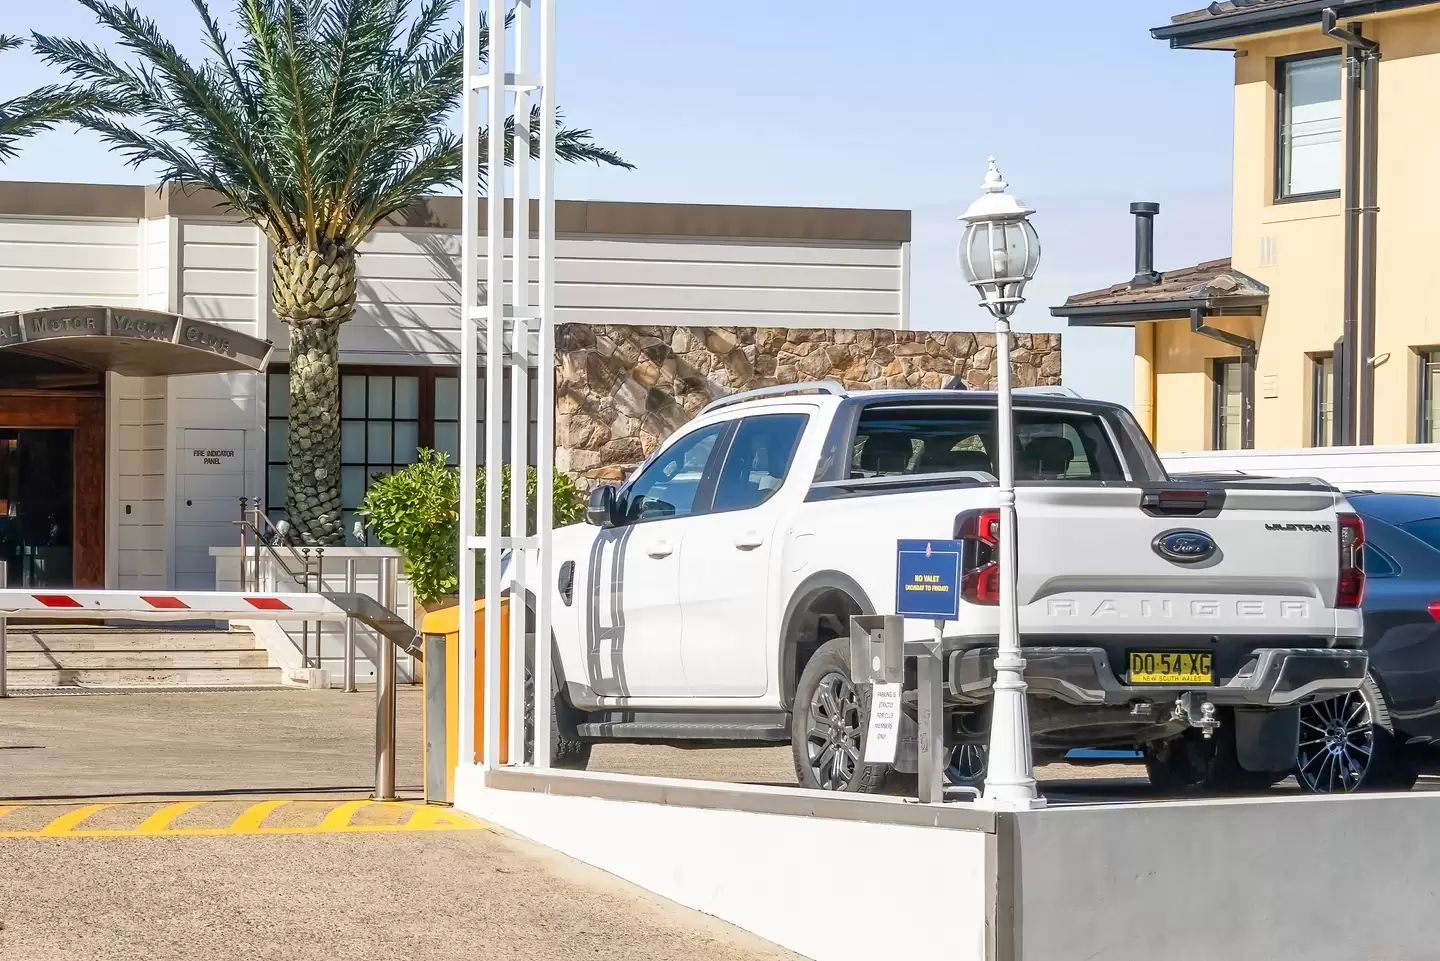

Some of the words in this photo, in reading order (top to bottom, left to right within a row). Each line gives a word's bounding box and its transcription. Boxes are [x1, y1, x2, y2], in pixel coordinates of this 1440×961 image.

[33, 316, 96, 333] MOTOR
[203, 457, 221, 465] PANEL
[1265, 523, 1332, 533] WILDTRAK
[914, 574, 923, 582] NO
[923, 575, 940, 583] VALET
[1047, 599, 1309, 619] RANGER
